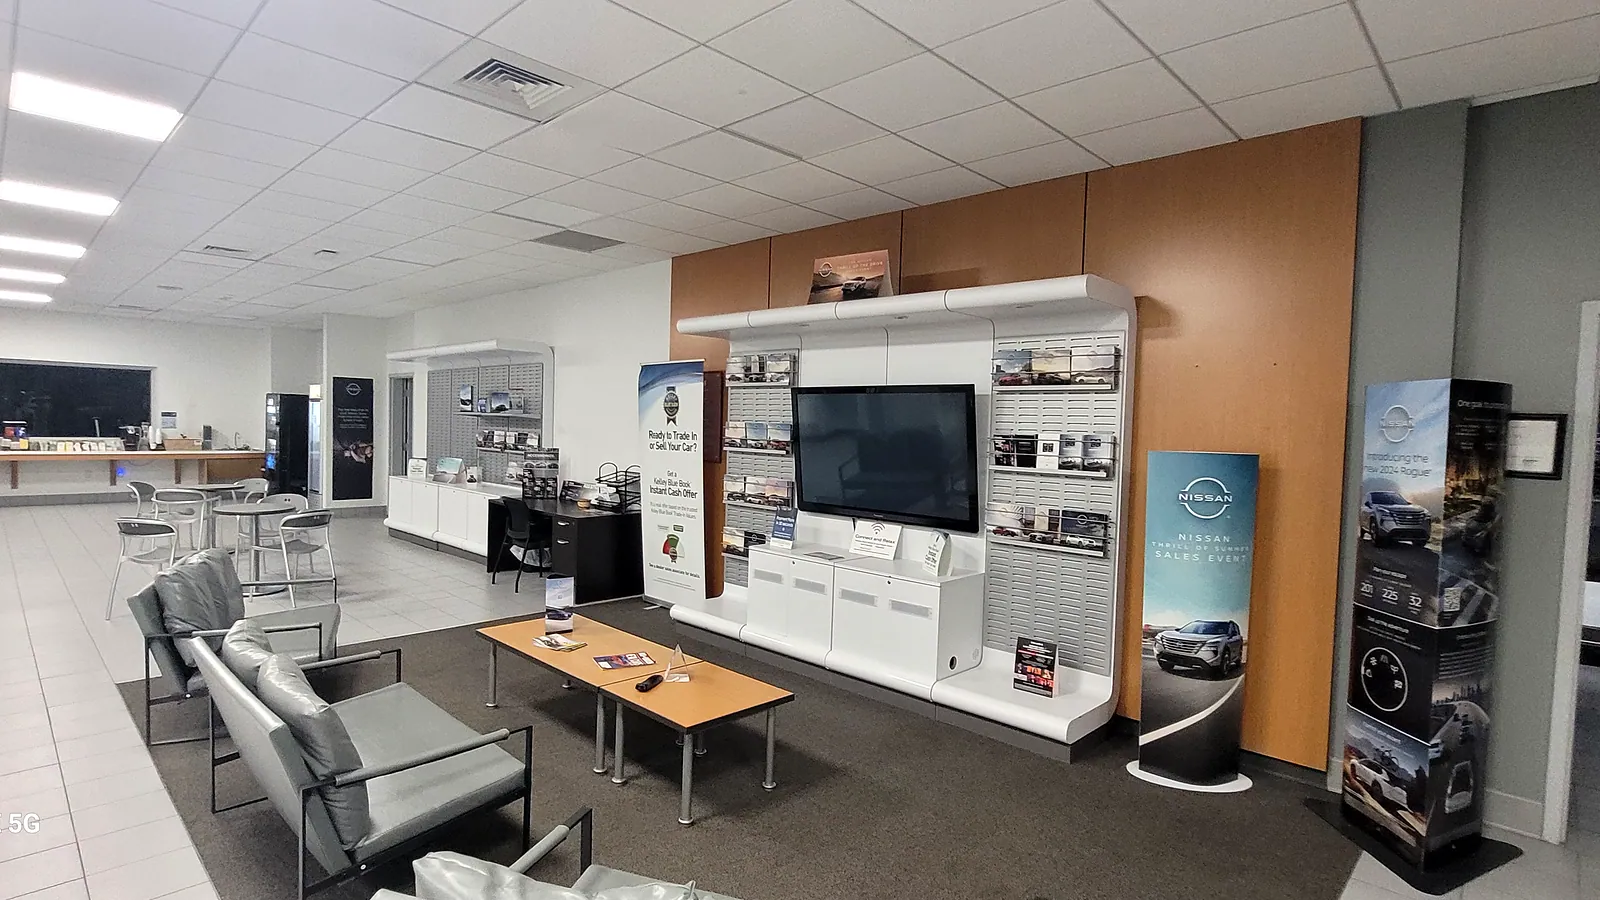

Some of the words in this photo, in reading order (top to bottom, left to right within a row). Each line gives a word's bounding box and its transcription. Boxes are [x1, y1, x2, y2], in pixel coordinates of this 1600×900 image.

[648, 430, 665, 441] Ready
[667, 431, 672, 440] to
[673, 431, 690, 440] Trade
[691, 432, 697, 440] In
[656, 442, 666, 450] Sell
[668, 442, 681, 451] Your
[682, 443, 697, 452] Car?
[1366, 453, 1411, 464] Introducing
[1413, 454, 1429, 463] the
[1380, 466, 1399, 474] 2024
[654, 478, 667, 487] Kelley
[650, 485, 667, 495] Instant
[668, 488, 682, 497] Cash
[683, 489, 698, 498] Offer
[1178, 493, 1233, 502] NISSAN
[1178, 534, 1230, 542] NISSAN
[1152, 542, 1189, 550] THRILL
[1155, 551, 1200, 561] SALES
[1360, 582, 1373, 594] 201
[1382, 588, 1399, 601] 225
[1409, 595, 1422, 607] 32
